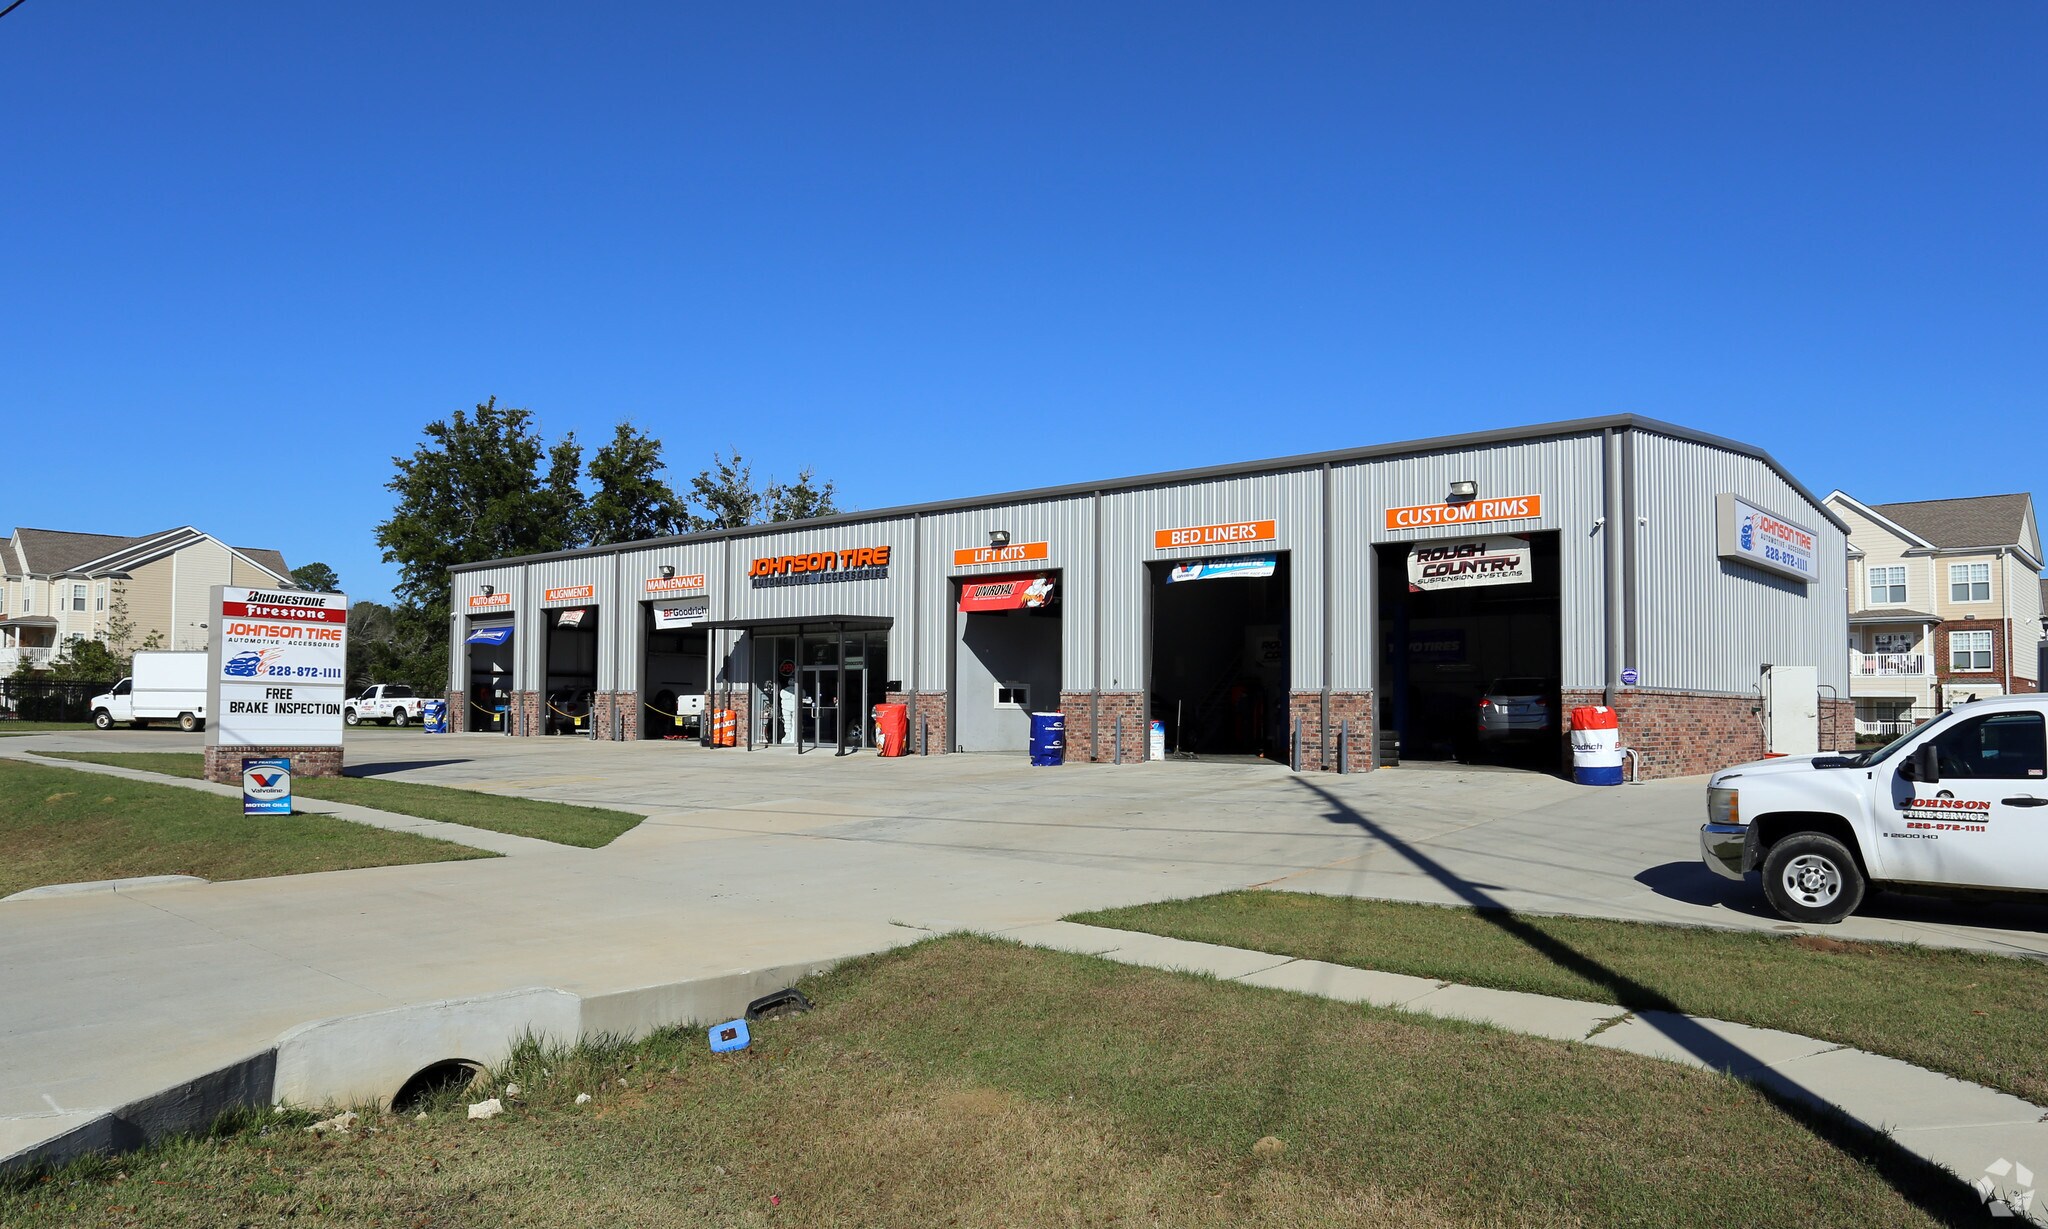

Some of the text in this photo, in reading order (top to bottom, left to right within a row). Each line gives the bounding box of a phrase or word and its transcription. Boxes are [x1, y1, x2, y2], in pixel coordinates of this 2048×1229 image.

[1396, 498, 1528, 526] CUSTOM RIMS
[1171, 524, 1257, 545] BED LINERS
[1760, 516, 1811, 550] JOHNSON TIRE
[748, 545, 890, 576] JOHNSON TIRE
[974, 546, 1026, 562] LIFT KITS
[1417, 543, 1487, 563] ROUGH
[1765, 545, 1808, 572] 228-872-1111
[1422, 556, 1521, 578] COUNTRY
[647, 576, 703, 590] MAINTENANCE
[752, 568, 889, 589] AUTOMOTIVE ACCESSORIES
[1417, 570, 1523, 585] SUSPENSION SYSTEMS
[549, 587, 589, 599] ALIGNMENTS
[975, 584, 1014, 597] UNIROYAL
[246, 591, 326, 607] BRIDGESTONE
[472, 594, 508, 606] AUTO REPAIR
[245, 604, 326, 619] Firestone
[663, 606, 707, 617] BFGoodrich
[226, 623, 342, 641] JOHNSON TIRE
[228, 637, 340, 648] AUTOMOTIVE ACCESSORIES
[268, 666, 341, 678] 228-872-1111
[266, 688, 293, 700] FREE
[230, 702, 341, 715] BRAKE INSPECTION
[1899, 797, 1991, 811] JOHNSON
[1907, 810, 1985, 821] TIRE SERVICE
[1906, 822, 1986, 832] 228-872-1111
